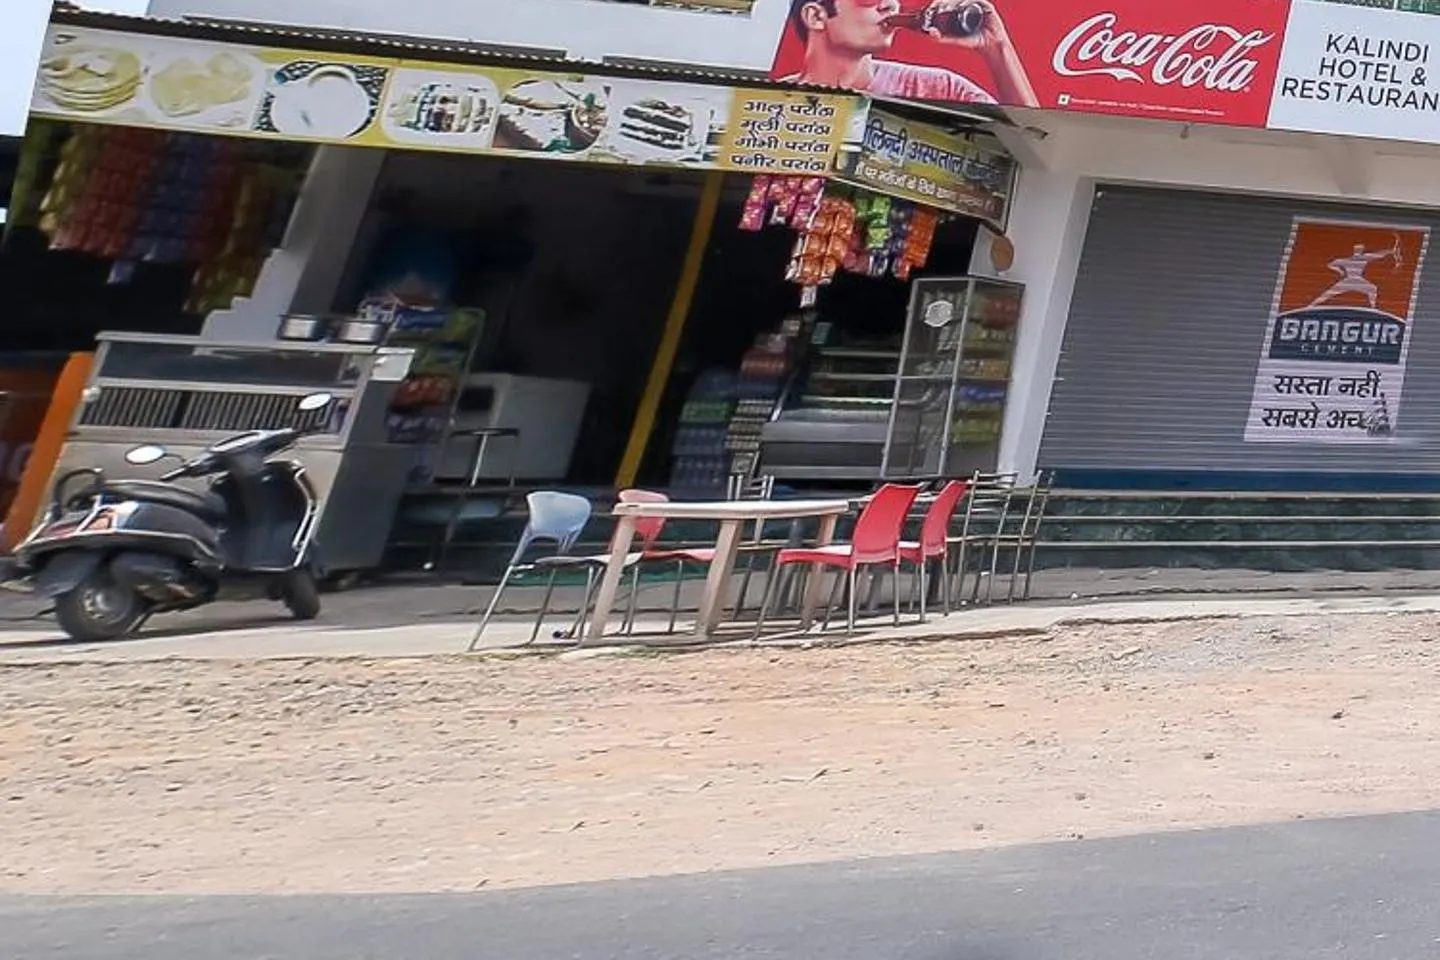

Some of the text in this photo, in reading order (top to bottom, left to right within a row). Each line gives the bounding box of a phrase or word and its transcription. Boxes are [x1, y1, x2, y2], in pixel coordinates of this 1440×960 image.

[1052, 12, 1276, 93] Coca-Cola
[1325, 33, 1429, 64] KALINDI
[1318, 56, 1428, 86] HOTEL &
[1279, 318, 1400, 345] BANGUR
[1300, 343, 1374, 355] CEMENT
[1273, 374, 1332, 397] सस्ता
[1261, 401, 1320, 429] सबसे
